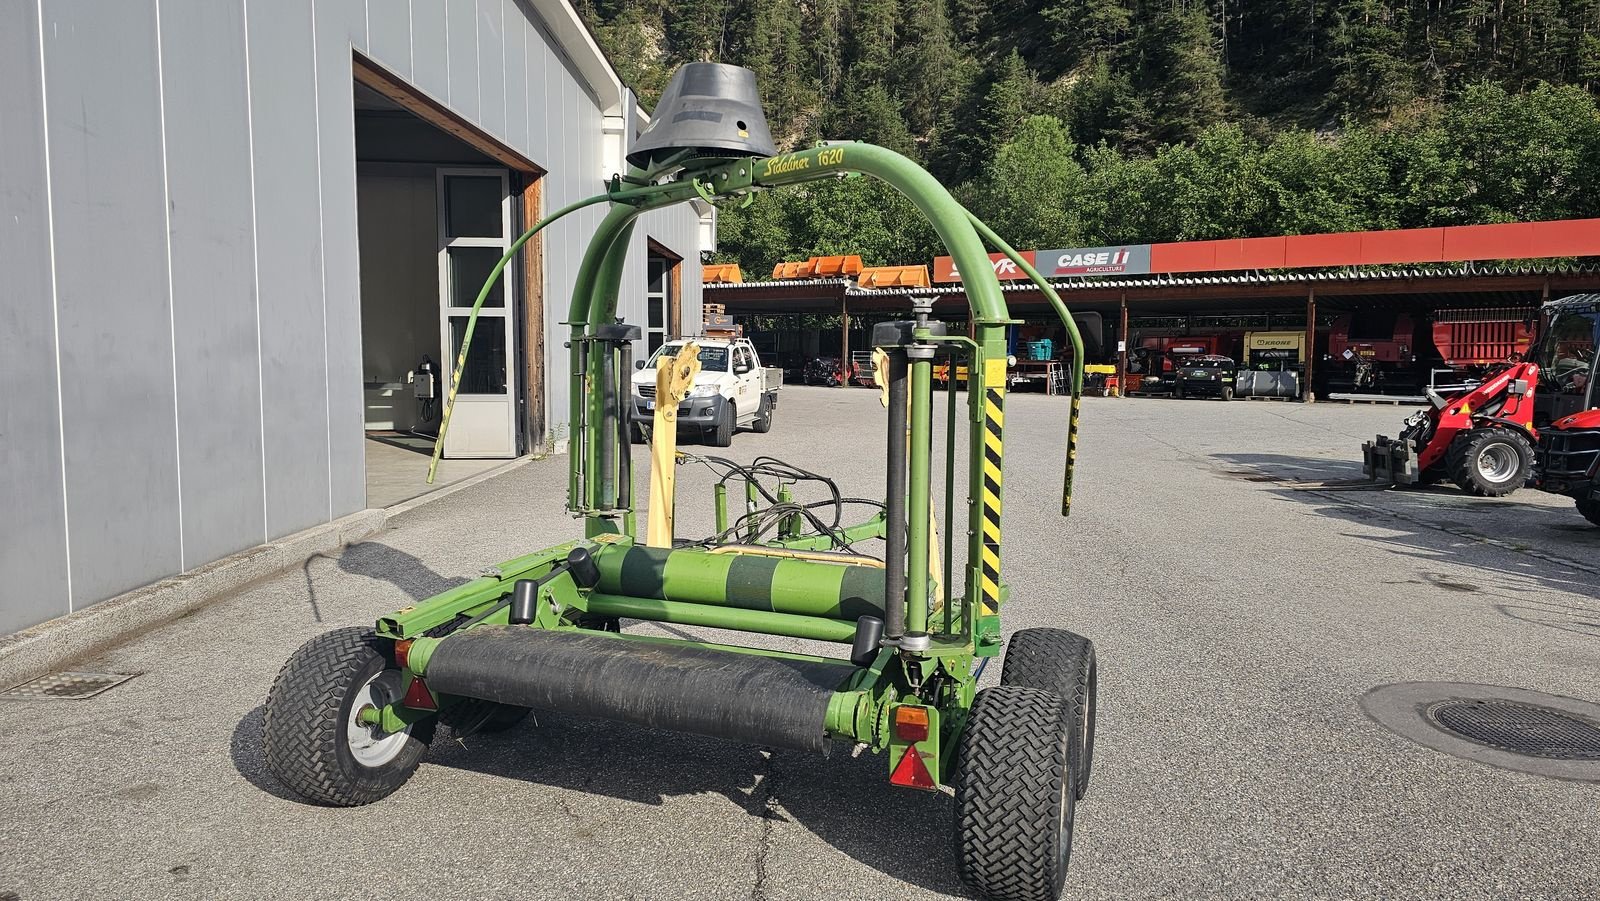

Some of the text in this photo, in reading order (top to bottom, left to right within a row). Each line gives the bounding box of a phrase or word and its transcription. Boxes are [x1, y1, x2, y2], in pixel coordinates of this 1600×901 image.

[763, 148, 844, 177] Sideliner 1620
[1057, 252, 1110, 267] CASE
